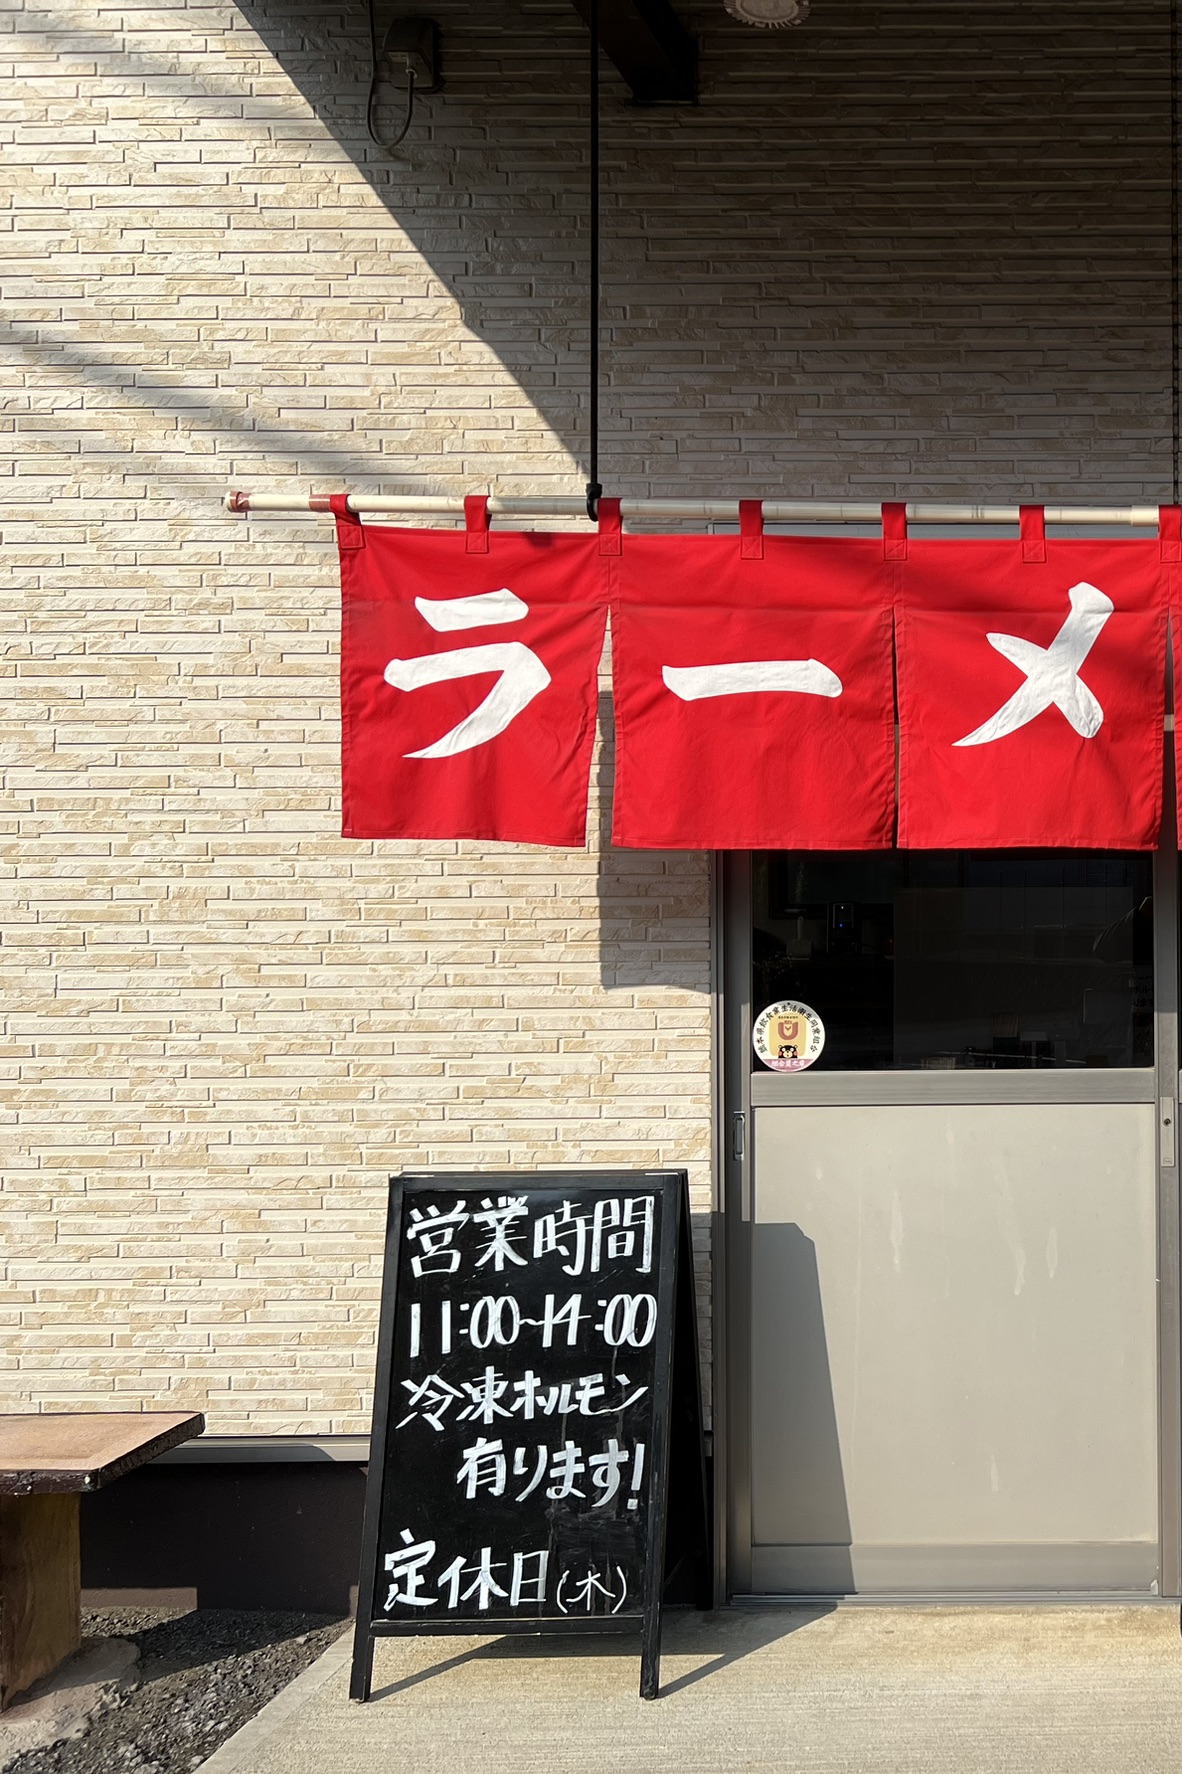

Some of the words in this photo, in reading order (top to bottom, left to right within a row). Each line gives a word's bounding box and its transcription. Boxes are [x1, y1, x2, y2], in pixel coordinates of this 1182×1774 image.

[407, 1195, 655, 1278] 営業時間
[395, 1366, 648, 1431] 冷凍ホルモン
[456, 1437, 646, 1510] 有ります!
